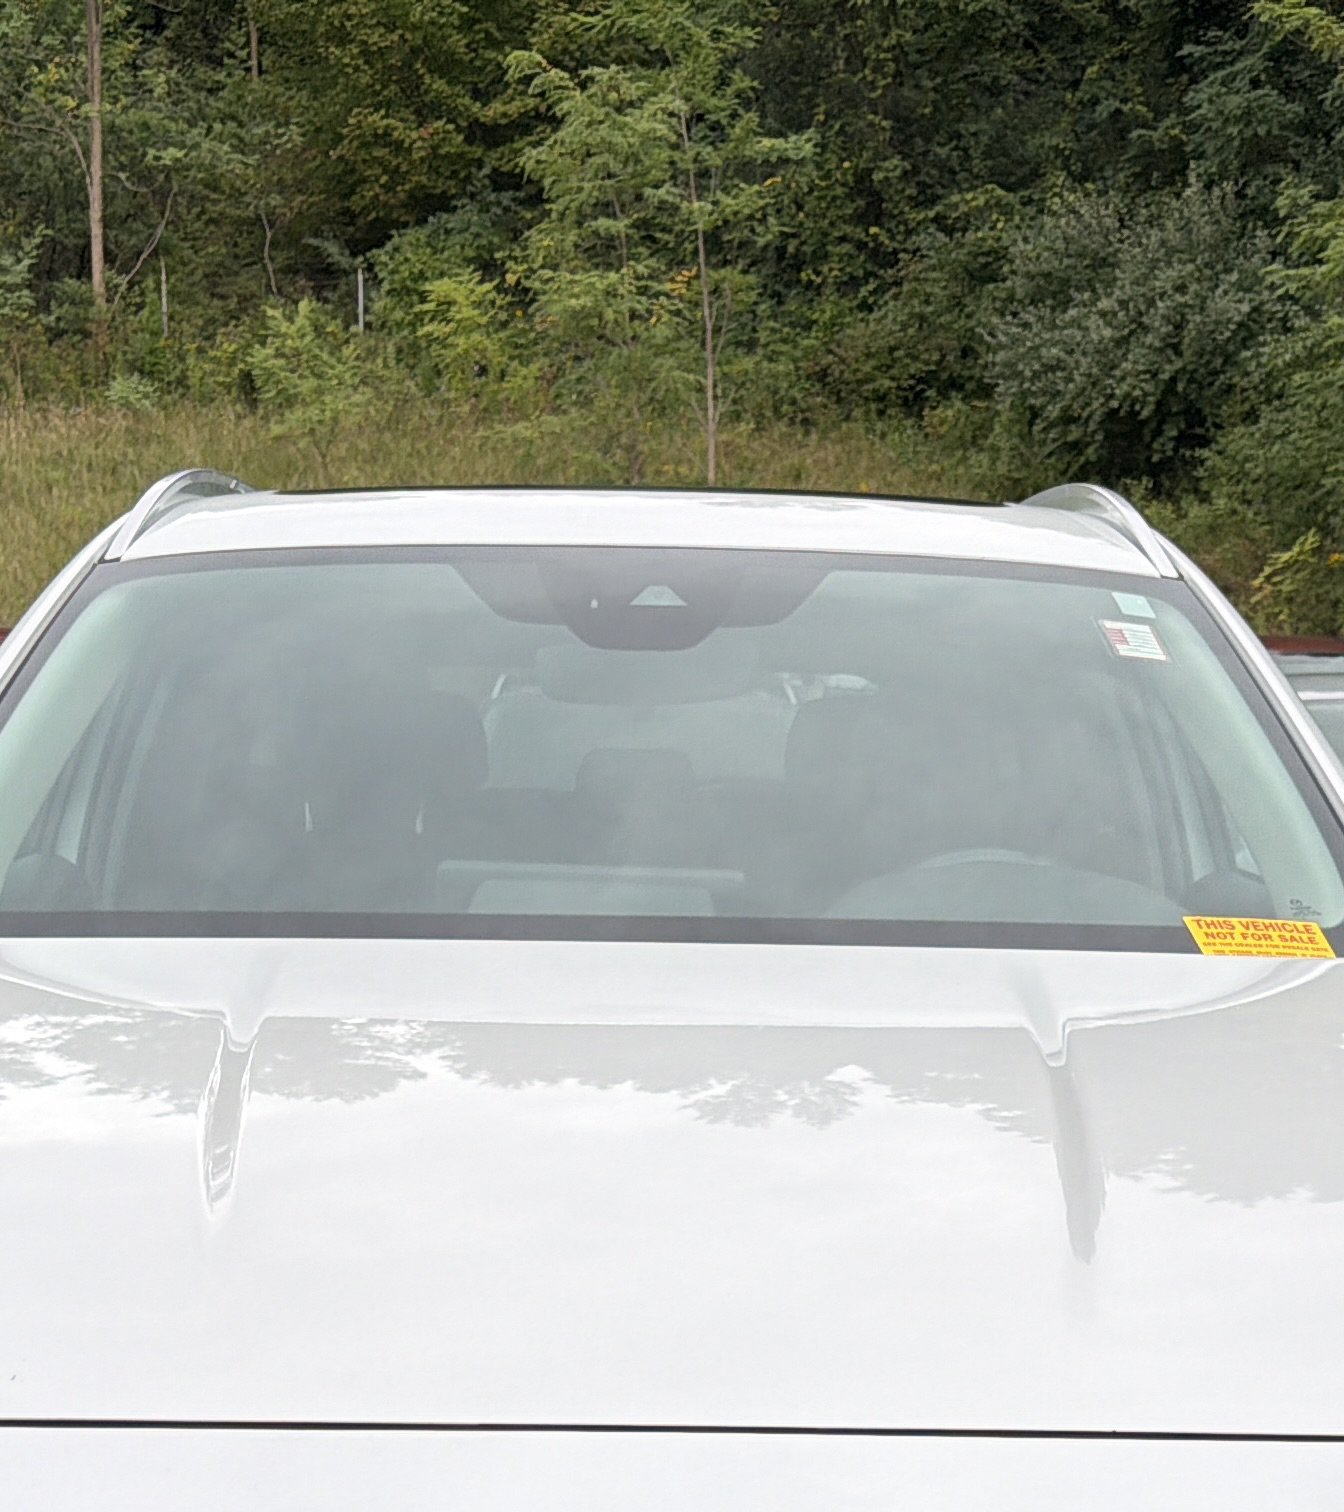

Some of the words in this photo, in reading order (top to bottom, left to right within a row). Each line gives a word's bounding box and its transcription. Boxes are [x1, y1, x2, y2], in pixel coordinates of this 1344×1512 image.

[1191, 919, 1236, 931] THIS
[1238, 920, 1317, 935] VEHICLE
[1204, 931, 1236, 941] NOT
[1241, 932, 1274, 942] FOR
[1278, 934, 1320, 945] SALE
